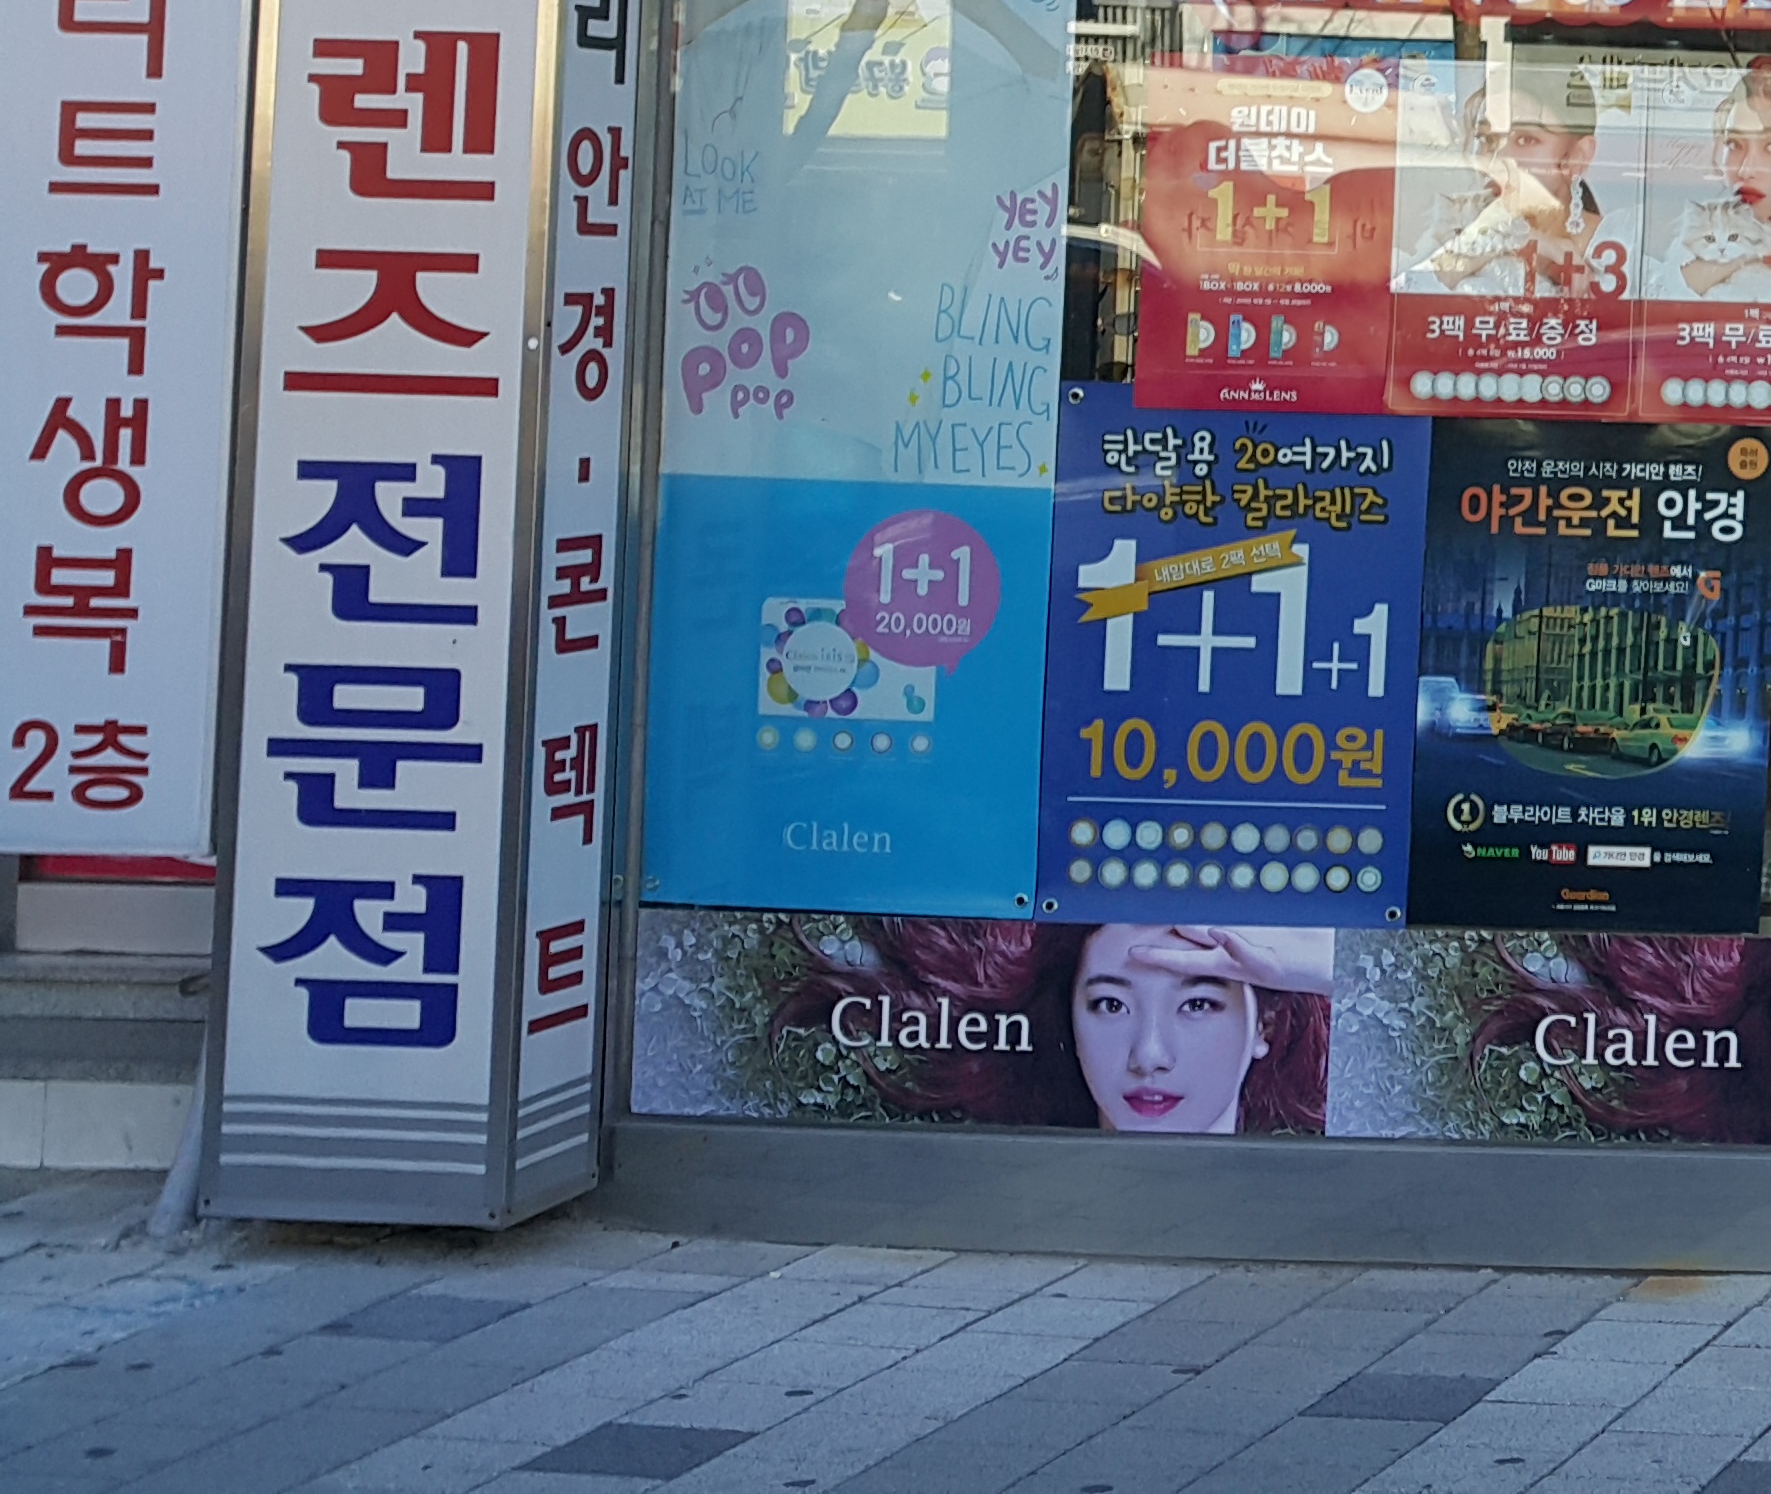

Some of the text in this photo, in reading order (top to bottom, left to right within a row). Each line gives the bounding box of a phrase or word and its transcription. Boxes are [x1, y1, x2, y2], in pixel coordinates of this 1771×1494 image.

[1230, 104, 1317, 133] 원데이
[682, 142, 761, 186] LOOK
[1207, 136, 1334, 172] 더블찬스
[716, 188, 756, 215] ME
[1208, 181, 1333, 244] 1+1
[1514, 239, 1629, 301] 1+3
[933, 282, 1055, 354] BLING
[1425, 315, 1466, 342] 3팩
[1676, 322, 1716, 350] 3팩
[940, 354, 1053, 422] BLING
[1102, 425, 1395, 477] 한달용 20여가지
[1507, 459, 1537, 478] 안전
[1541, 460, 1585, 479] 운전의
[1588, 461, 1618, 479] 시작
[1621, 462, 1665, 481] 가디안
[1102, 477, 1390, 529] 다양한 칼라렌즈
[1460, 483, 1746, 542] 야간운전 안경
[872, 542, 971, 607] 1+1
[1250, 540, 1282, 565] 선택
[875, 611, 971, 639] 20,000원
[8, 718, 150, 811] 2층
[1079, 717, 1385, 790] 10,000원
[783, 819, 893, 855] Clalen
[1577, 806, 1626, 826] 차단율
[1631, 809, 1657, 828] 1위
[1476, 846, 1520, 858] NAVER
[830, 996, 1034, 1054] Clalen
[1533, 1012, 1743, 1070] Clalen
